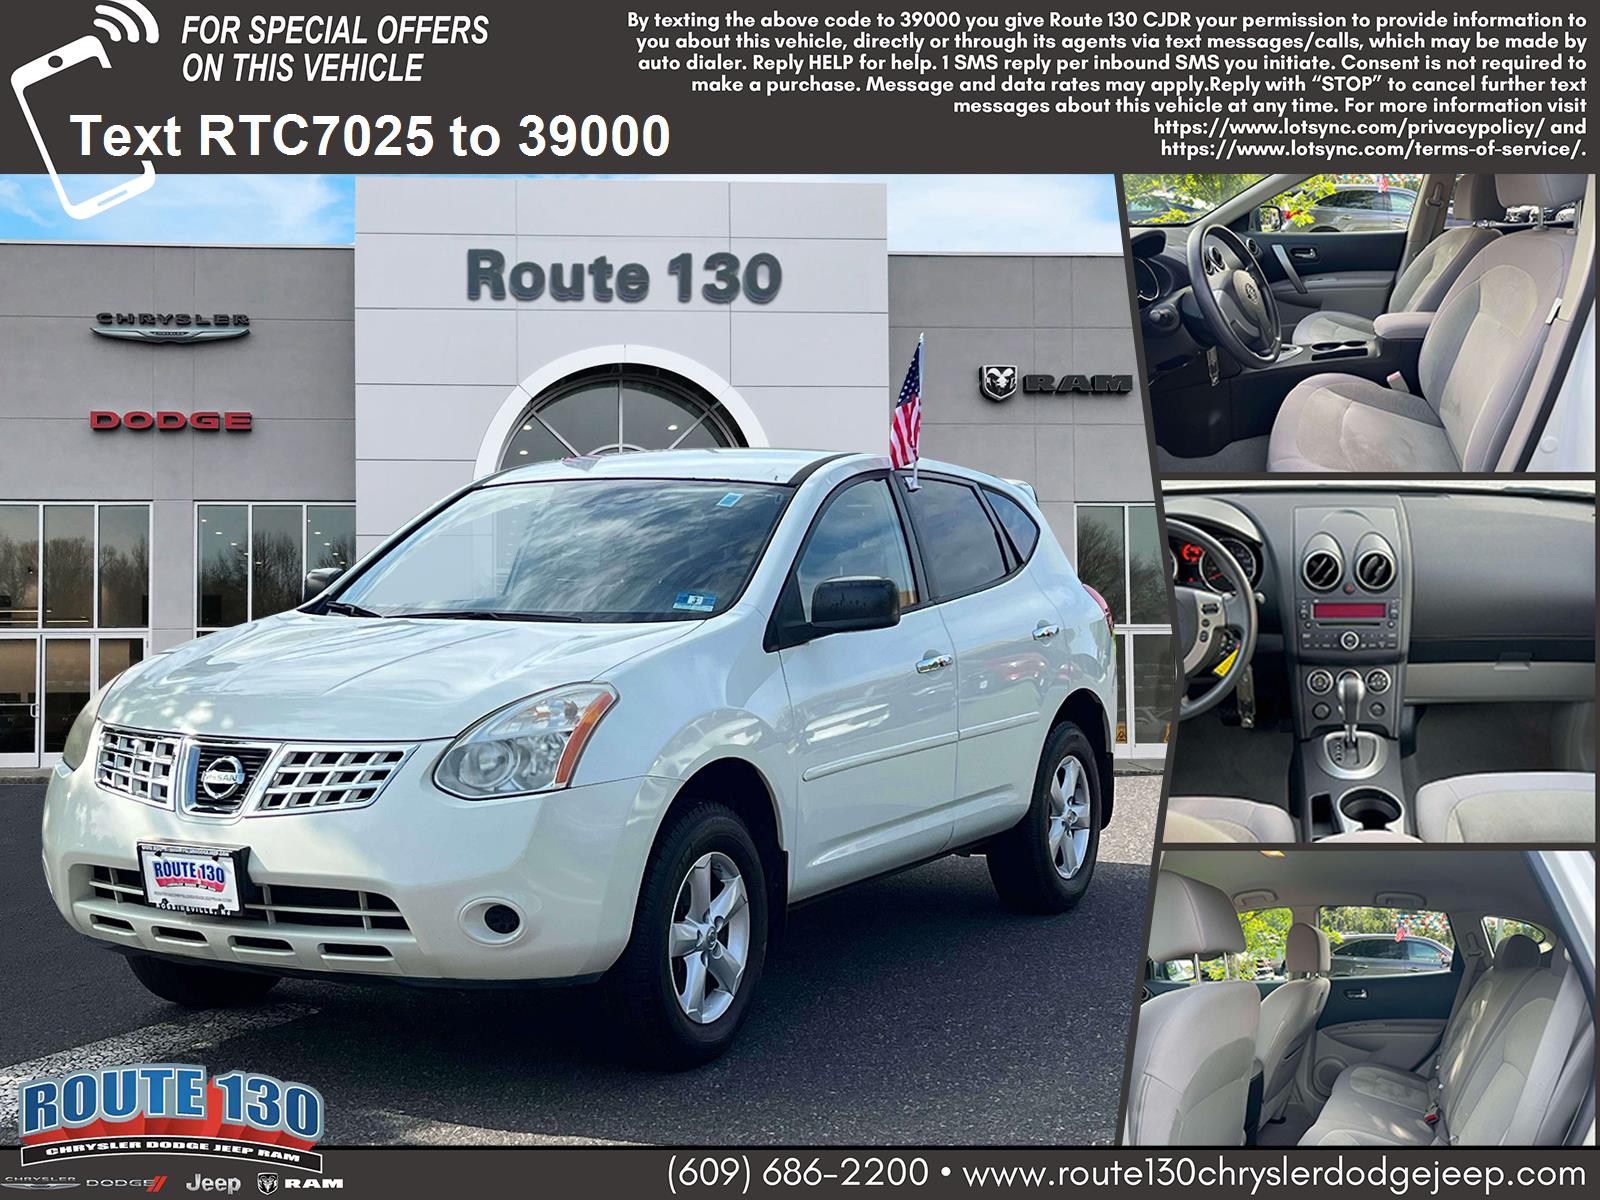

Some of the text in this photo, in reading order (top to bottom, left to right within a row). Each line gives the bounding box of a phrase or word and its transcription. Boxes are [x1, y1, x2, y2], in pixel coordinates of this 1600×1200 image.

[466, 248, 783, 305] Route 130
[96, 312, 250, 326] CHRYSLER
[1022, 374, 1133, 395] RAM
[90, 410, 253, 432] DODGE
[153, 861, 225, 883] ROUTE 130
